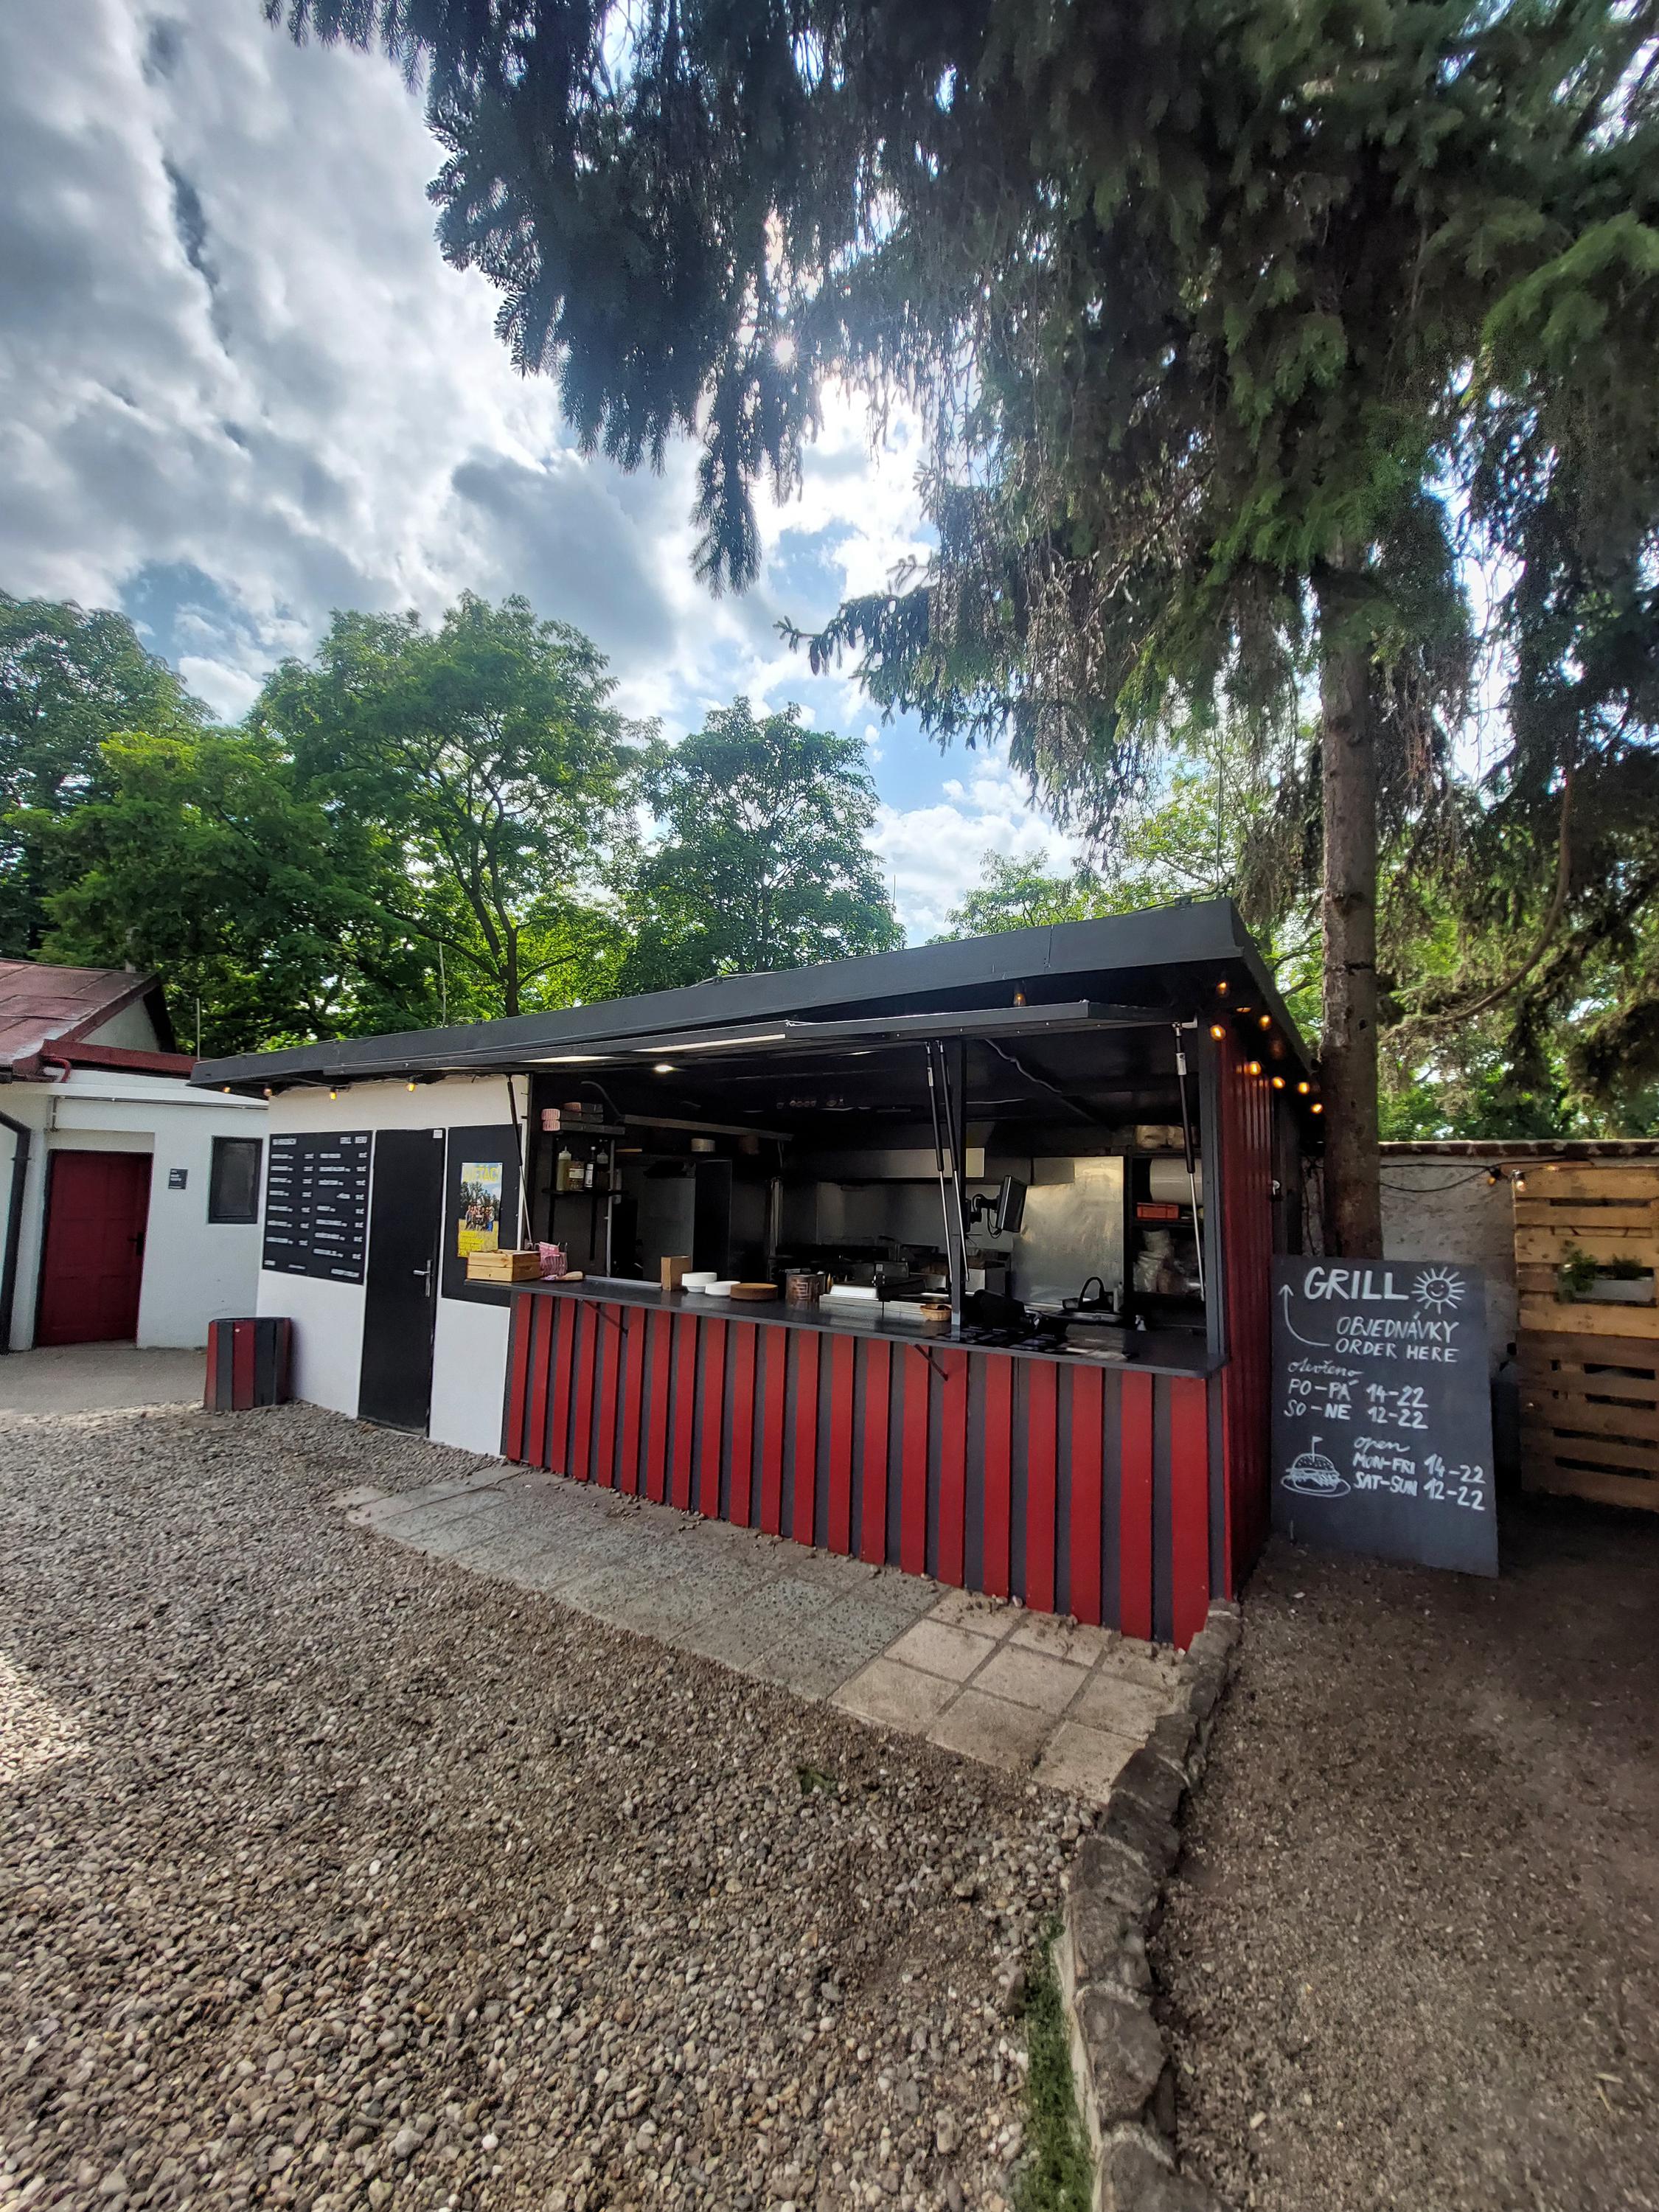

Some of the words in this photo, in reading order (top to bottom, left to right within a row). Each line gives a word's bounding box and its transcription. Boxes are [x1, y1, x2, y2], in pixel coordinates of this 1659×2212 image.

[1304, 1266, 1409, 1300] GRILL
[1337, 1312, 1459, 1343] OBJEDNÁVKY
[1335, 1338, 1398, 1358] ORDER
[1407, 1345, 1459, 1363] HERE
[1366, 1384, 1429, 1408] 14-22
[1283, 1399, 1352, 1421] SO-NE
[1367, 1406, 1429, 1430] 12-22
[1354, 1436, 1411, 1453] open
[1352, 1453, 1416, 1475] MON-FRI
[1423, 1454, 1485, 1485] 14-22
[1352, 1472, 1418, 1496] SAT-SUN
[1422, 1478, 1486, 1511] 12-22
